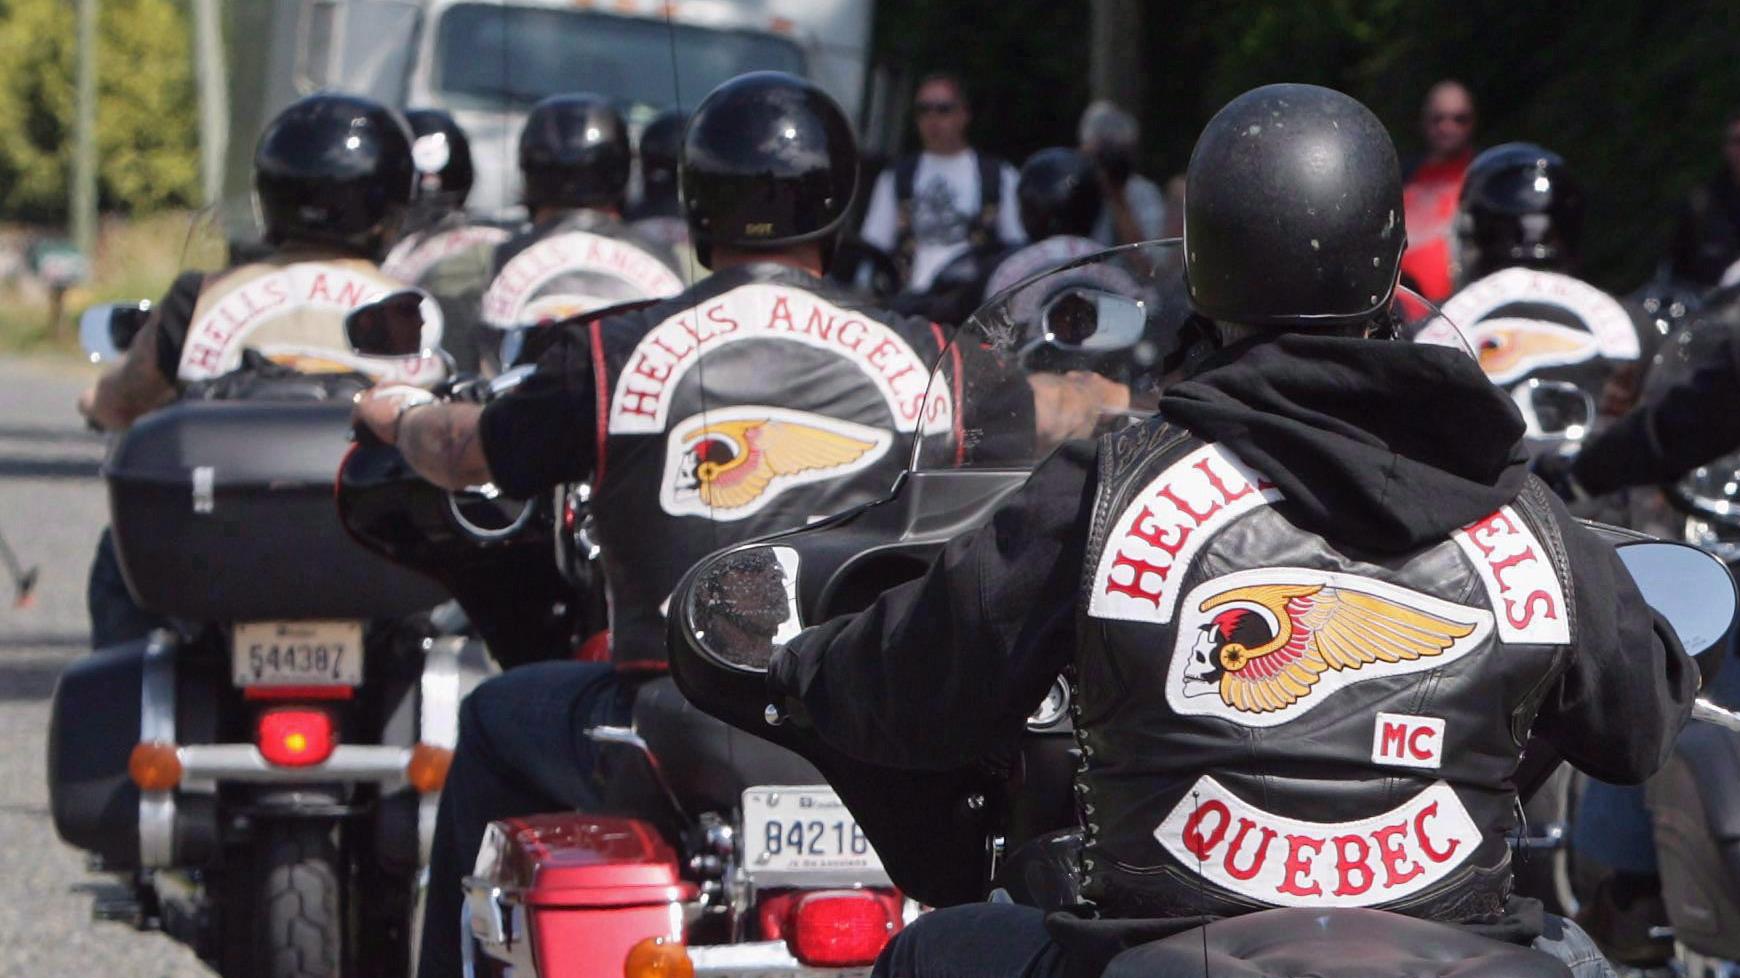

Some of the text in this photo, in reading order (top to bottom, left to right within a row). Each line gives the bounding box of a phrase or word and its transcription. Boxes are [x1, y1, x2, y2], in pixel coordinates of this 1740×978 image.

[188, 278, 287, 373] HELLS
[620, 297, 946, 422] HELLS ANGELS
[1105, 457, 1557, 630] HELL ELS
[1380, 722, 1437, 760] MC
[1182, 799, 1461, 897] QUEBEC
